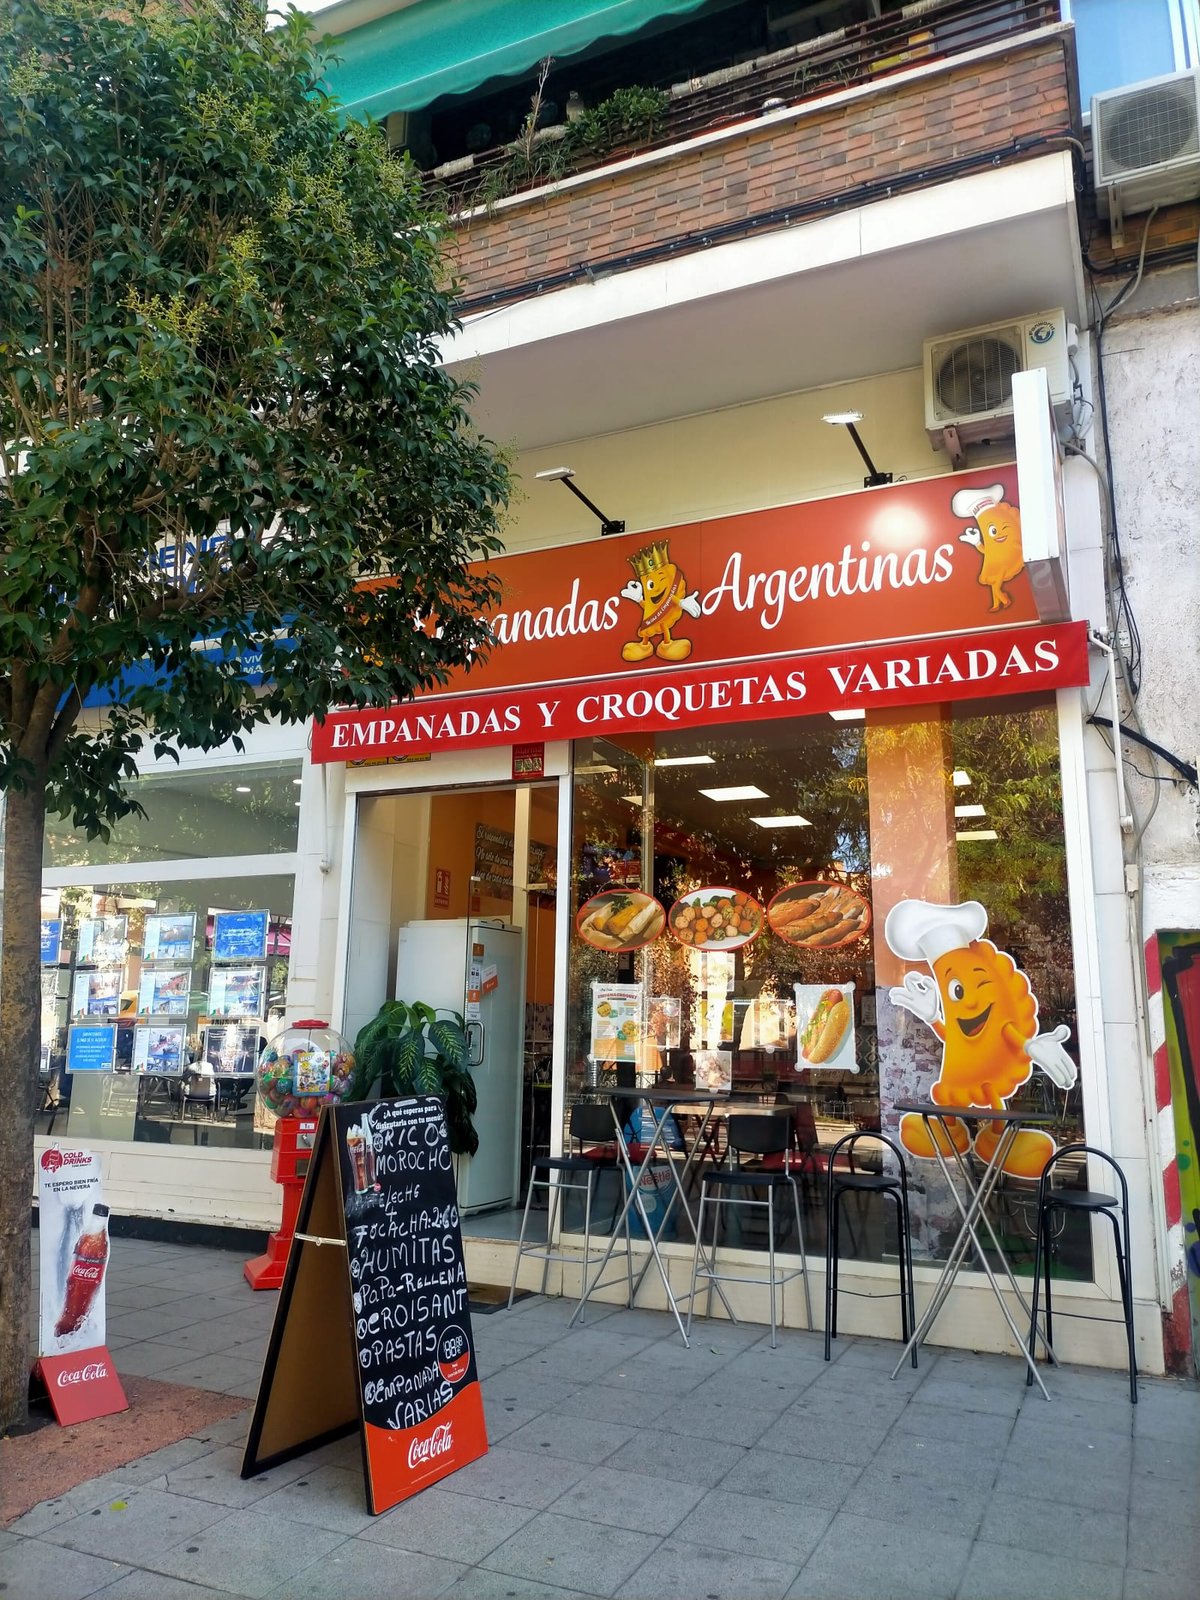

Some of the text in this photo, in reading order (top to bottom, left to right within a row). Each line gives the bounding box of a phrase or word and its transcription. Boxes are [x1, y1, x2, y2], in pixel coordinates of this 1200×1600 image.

[701, 540, 954, 629] Argentinas
[331, 640, 1060, 748] EMPANADAS Y CROQUETAS VARIADAS
[403, 1106, 424, 1116] esperas
[424, 1105, 437, 1114] para
[63, 1151, 83, 1159] COLD
[63, 1157, 92, 1166] DRINKS
[375, 1144, 452, 1176] MOROCHO
[52, 1180, 73, 1188] ESPERO
[371, 1325, 437, 1366] PASTAS
[57, 1362, 109, 1388] Coca-Cola
[408, 1420, 454, 1469] Coca-Cola
